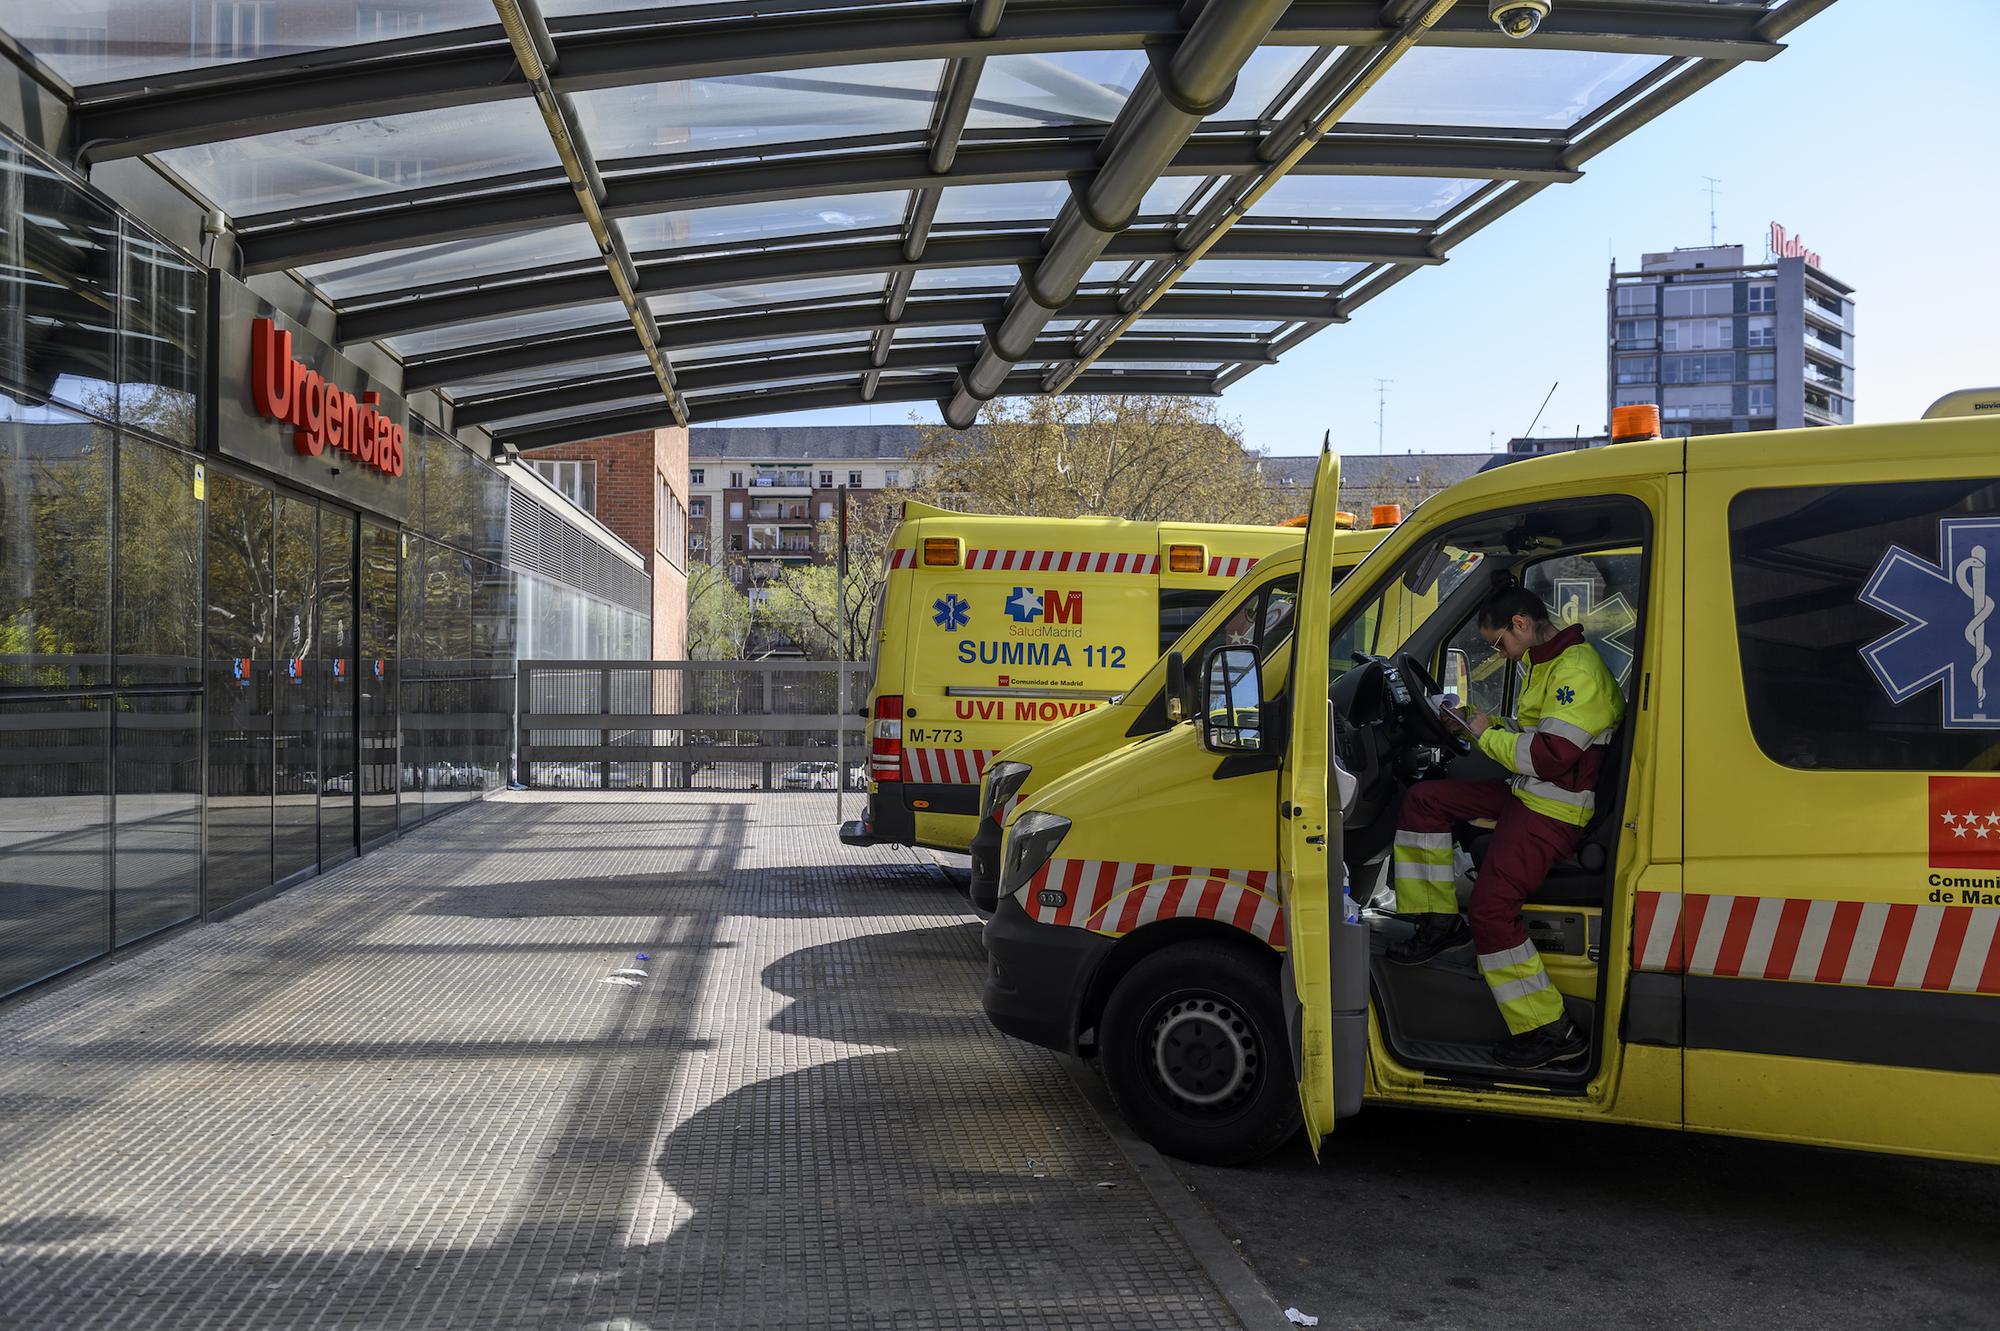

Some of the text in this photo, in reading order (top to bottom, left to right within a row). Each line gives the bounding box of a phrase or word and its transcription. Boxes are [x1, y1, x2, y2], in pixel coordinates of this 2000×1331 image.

[253, 318, 404, 477] Urgencias
[1009, 625, 1082, 638] SaludMadrid
[958, 640, 1126, 668] SUMMA 112
[1010, 678, 1048, 686] Comunidad
[955, 700, 1096, 721] UVI MOV
[909, 728, 963, 743] M-773
[1928, 889, 1954, 903] de
